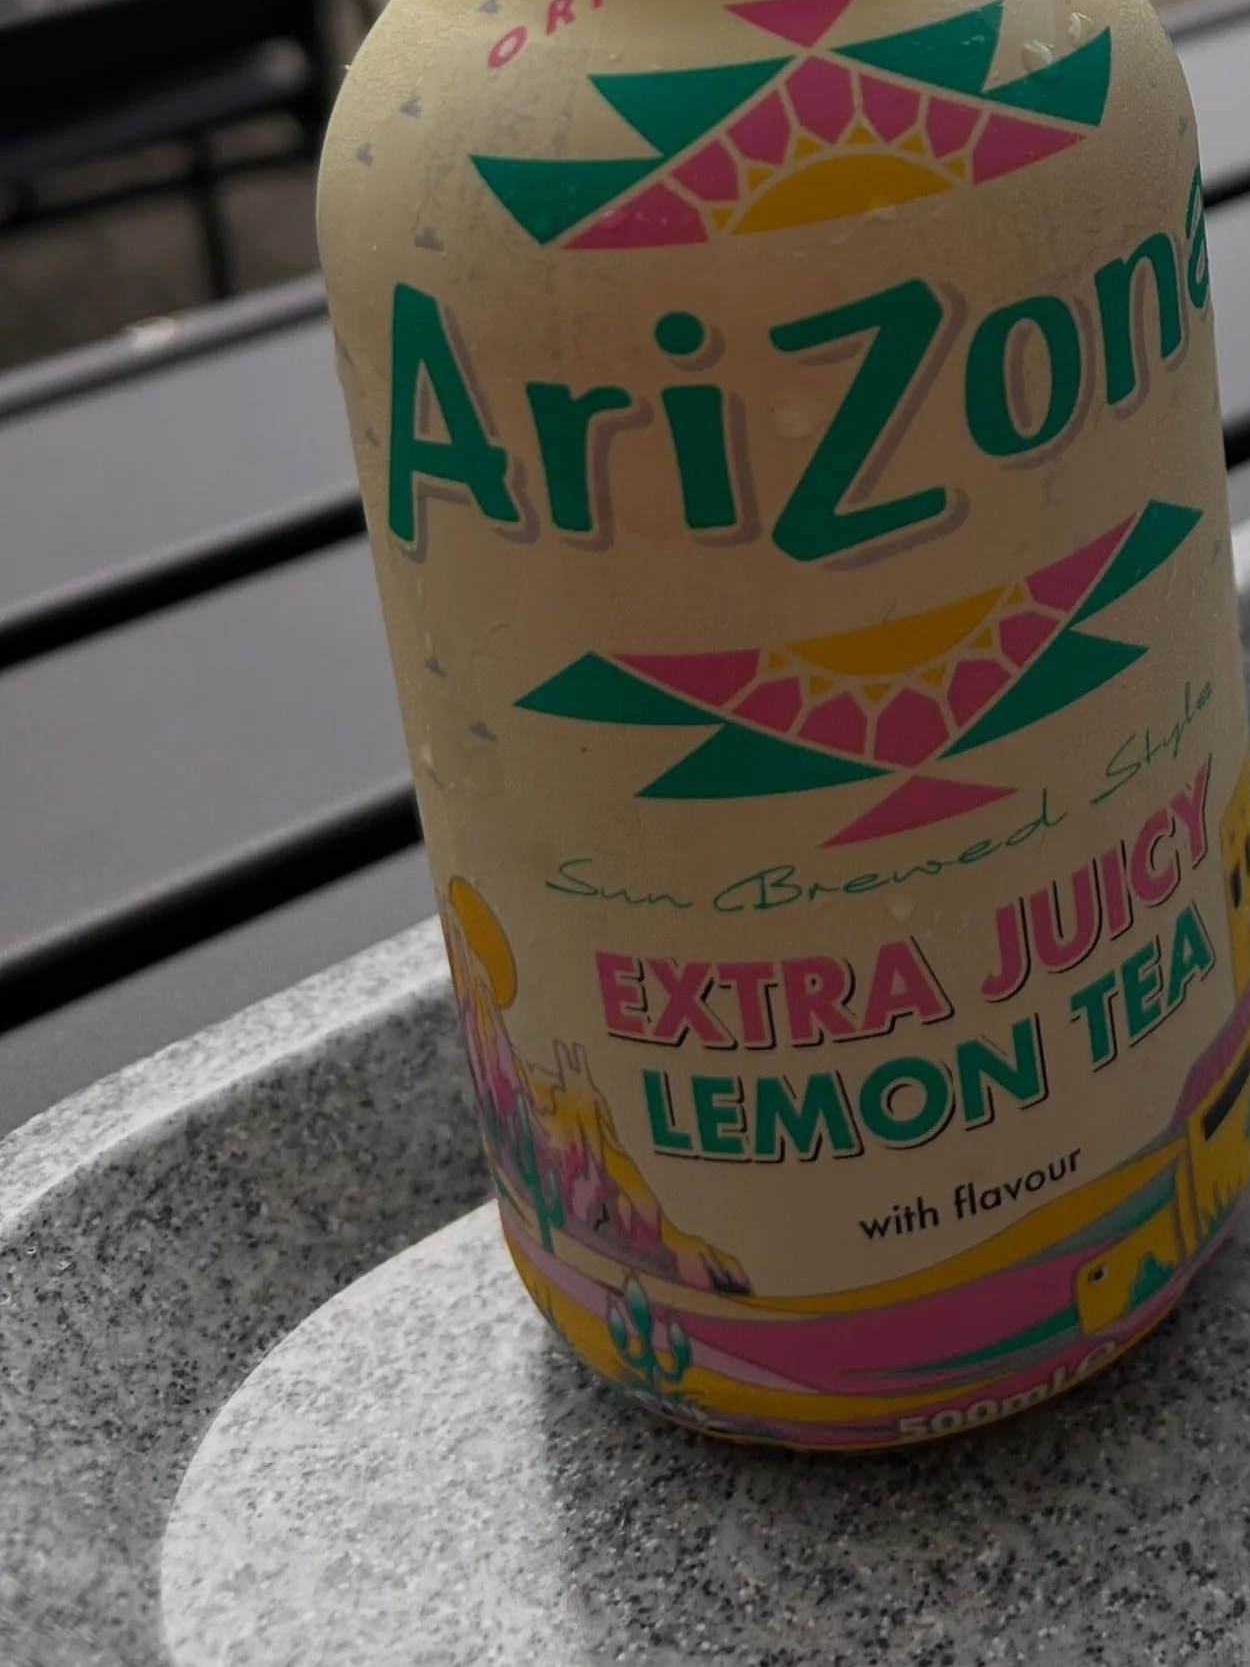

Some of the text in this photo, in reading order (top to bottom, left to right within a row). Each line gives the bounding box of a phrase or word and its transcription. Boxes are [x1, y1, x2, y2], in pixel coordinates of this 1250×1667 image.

[388, 163, 1209, 566] AriZona
[545, 679, 1214, 913] Sun Brewed Style
[594, 754, 1213, 1050] EXTRA JUICY
[640, 899, 1218, 1163] LEMON TEA
[858, 1147, 1082, 1242] with flavour
